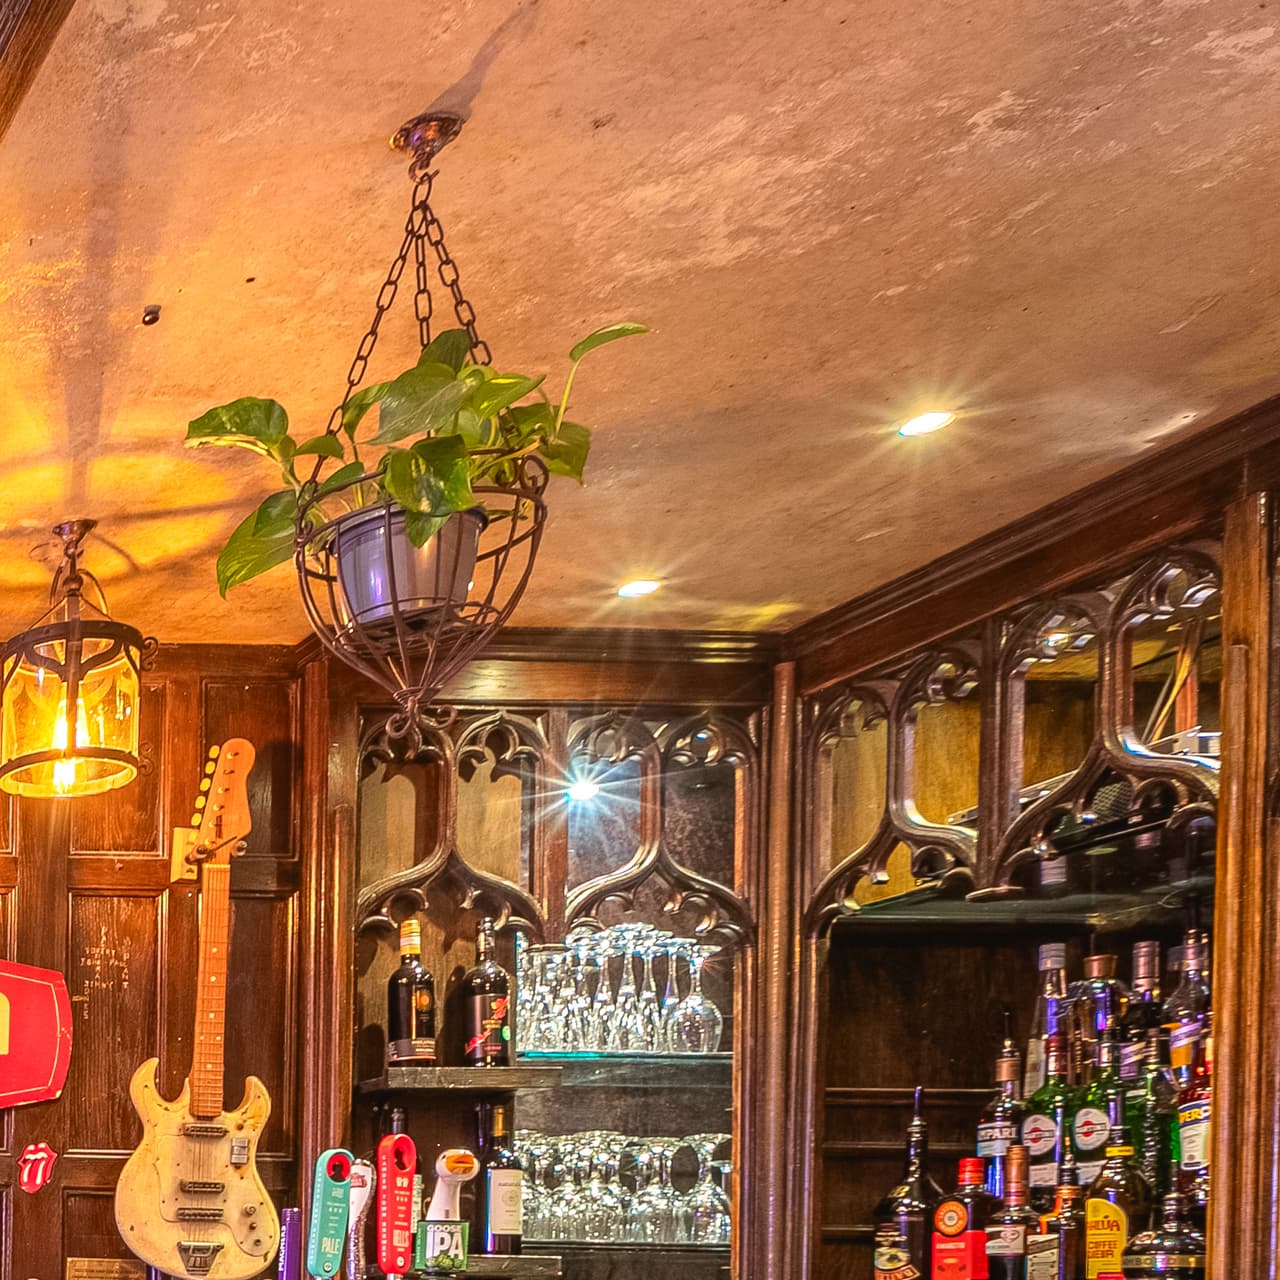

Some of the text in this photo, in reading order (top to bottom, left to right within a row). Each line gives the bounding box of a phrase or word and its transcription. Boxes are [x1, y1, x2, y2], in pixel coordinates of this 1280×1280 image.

[426, 1224, 462, 1232] GOOSE
[321, 1236, 340, 1254] PALE
[426, 1231, 464, 1261] IPA
